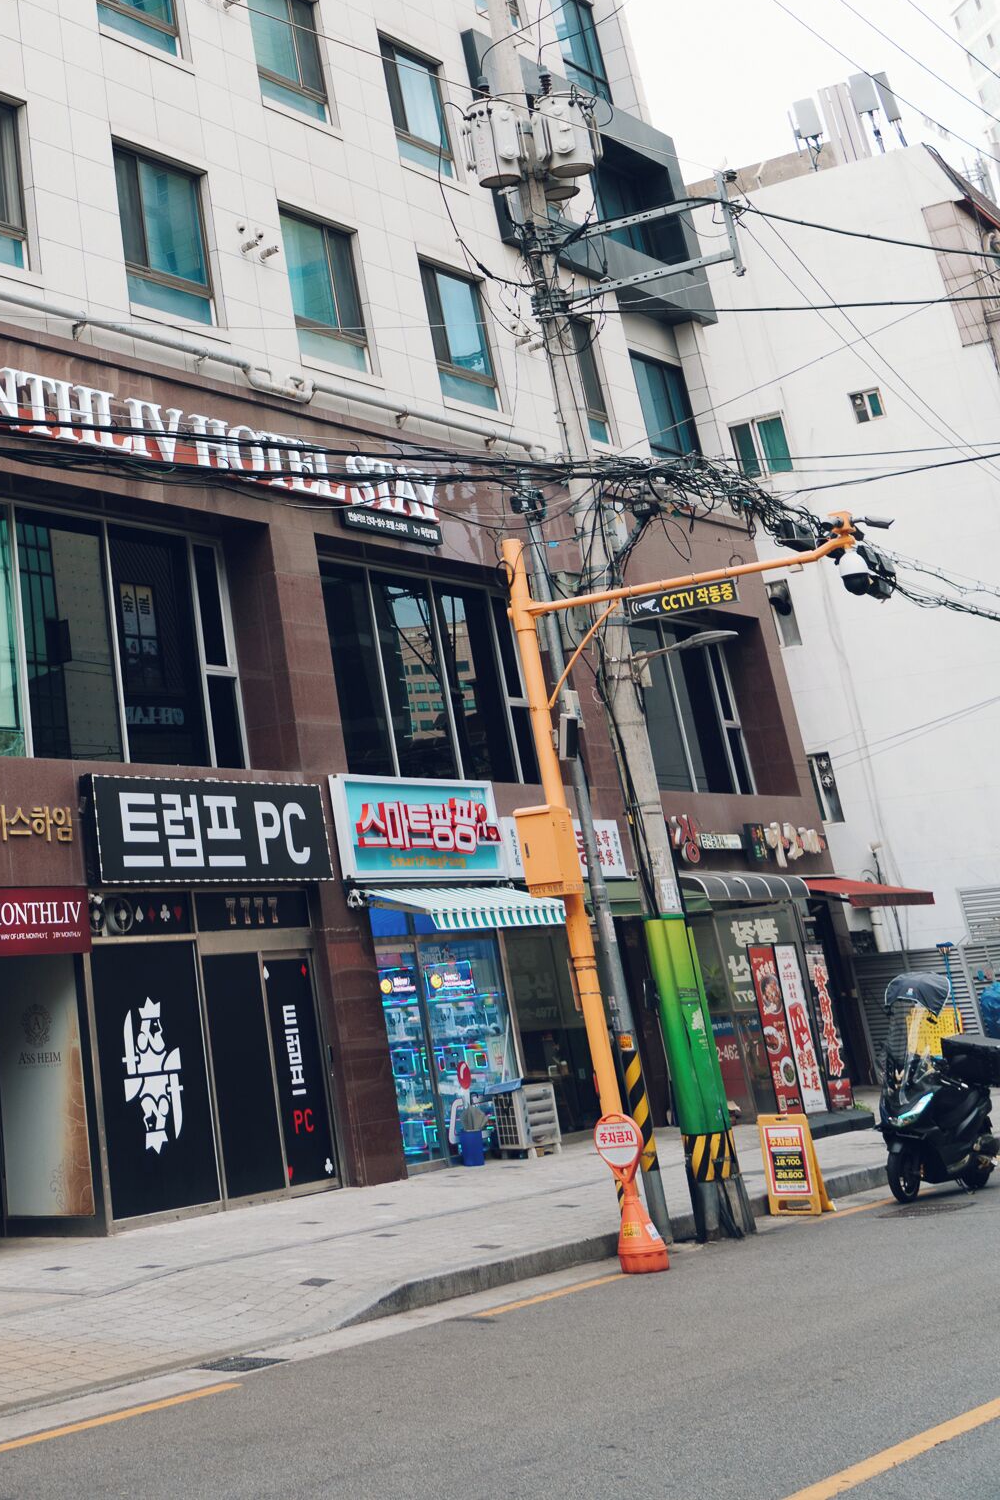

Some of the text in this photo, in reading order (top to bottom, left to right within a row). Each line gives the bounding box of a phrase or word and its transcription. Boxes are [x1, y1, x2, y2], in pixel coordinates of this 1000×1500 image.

[188, 413, 345, 500] HOTEL
[662, 583, 733, 611] CCTV 작동중
[119, 792, 311, 867] 트럼프 PC
[356, 798, 477, 854] 스마트팡팡
[671, 814, 700, 864] 장
[37, 1051, 61, 1064] HEIM
[282, 1005, 307, 1096] 트럼프
[293, 1108, 315, 1135] PC
[600, 1130, 634, 1143] 주차금지
